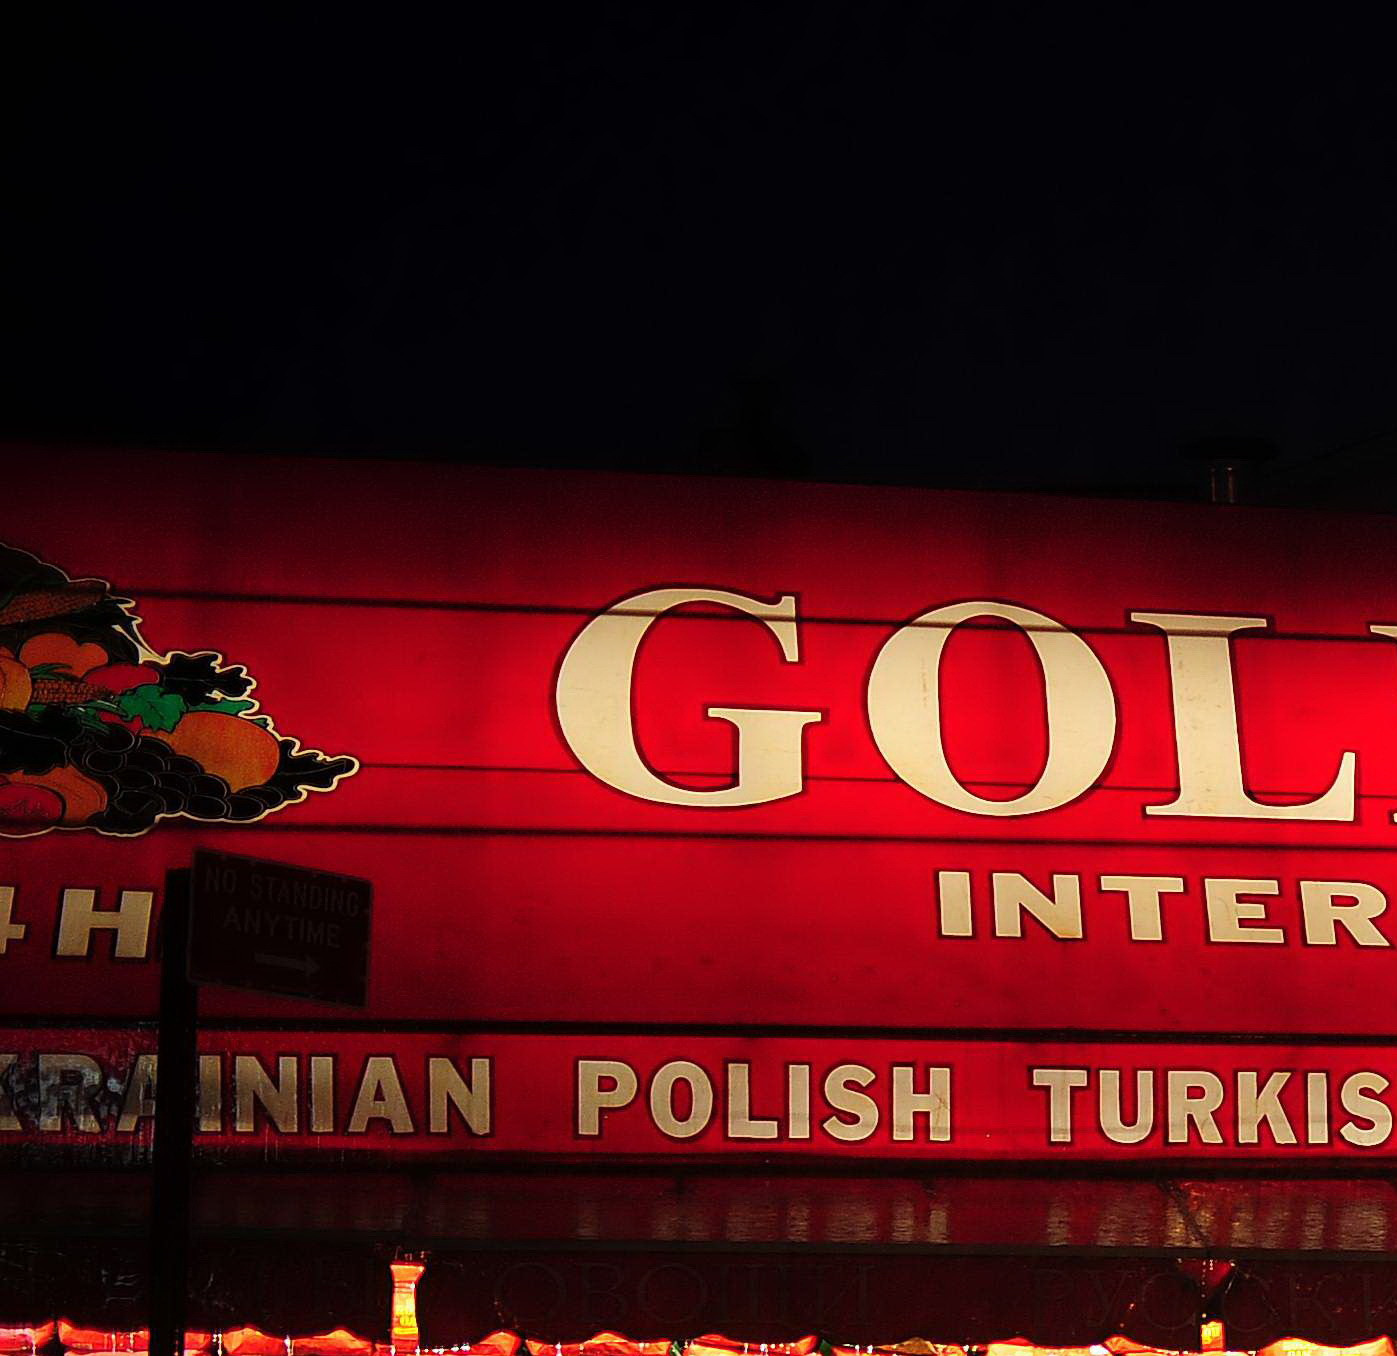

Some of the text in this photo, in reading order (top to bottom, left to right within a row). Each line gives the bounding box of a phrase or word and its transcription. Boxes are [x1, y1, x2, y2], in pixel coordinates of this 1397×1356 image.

[205, 864, 360, 918] NO STANDING
[224, 905, 342, 950] ANYTIME
[578, 1060, 951, 1143] POLISH
